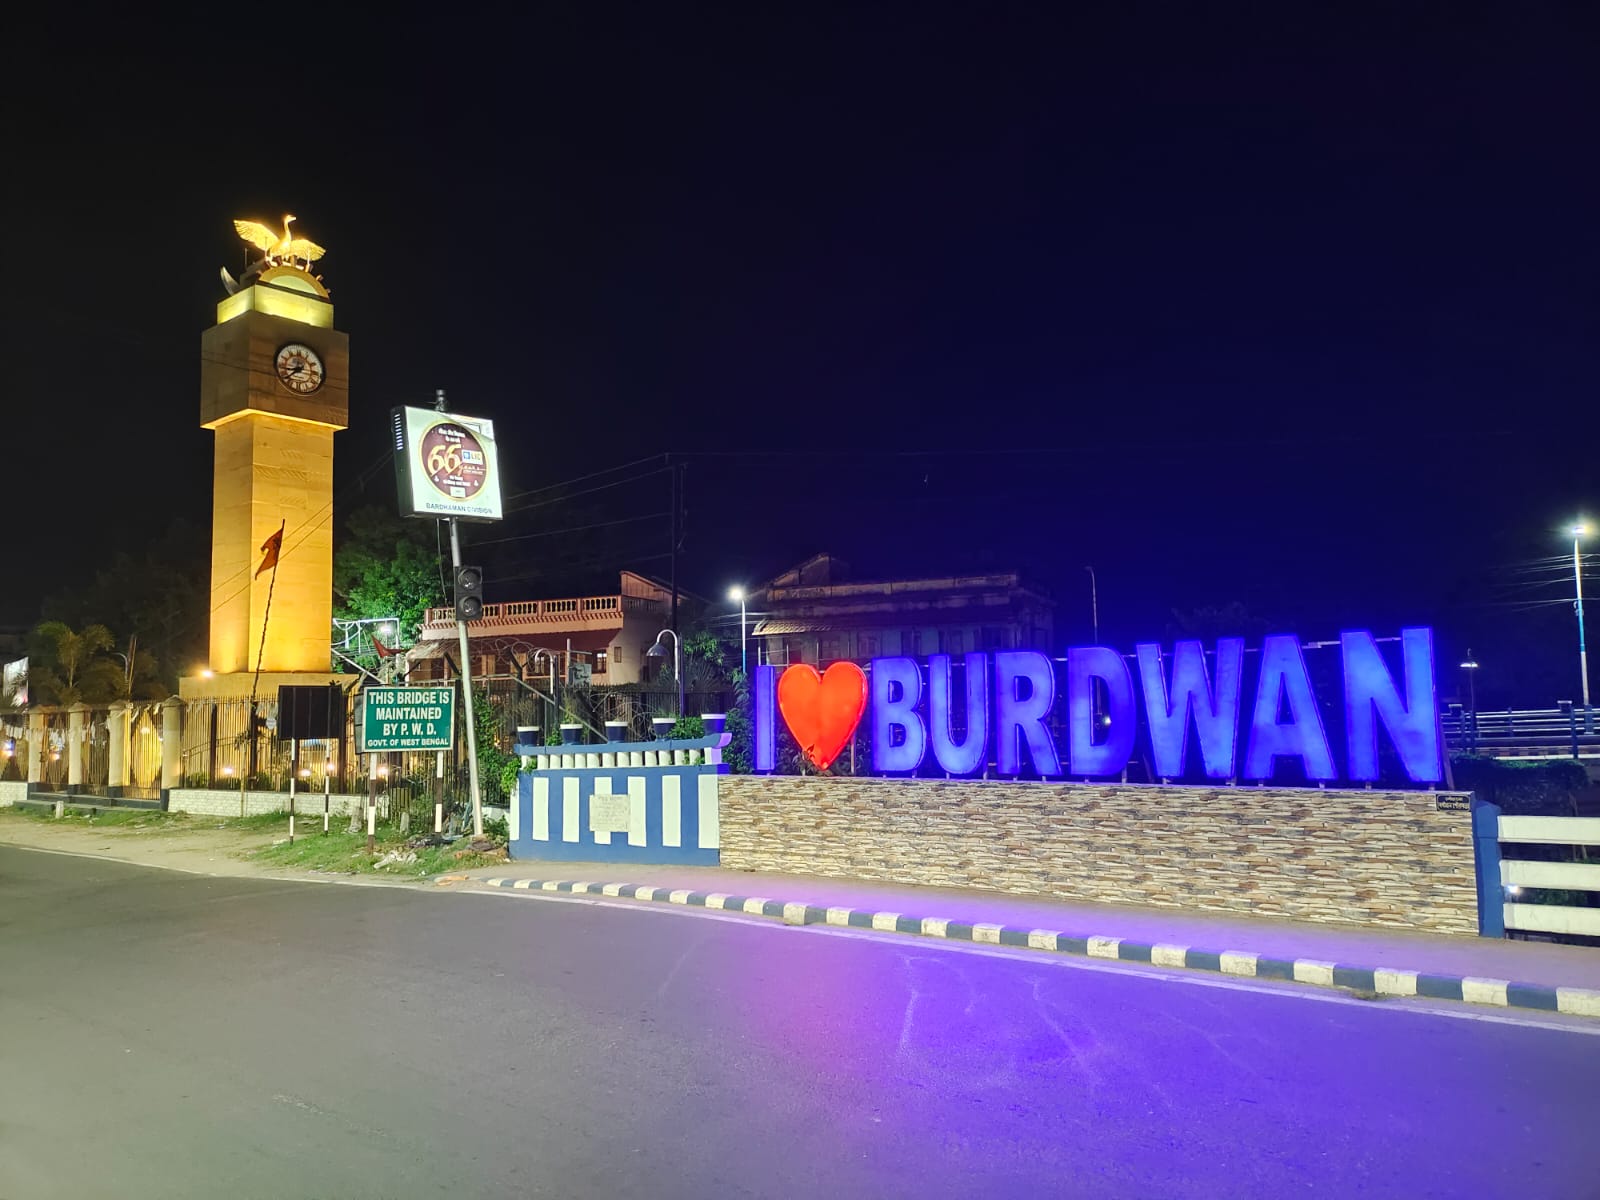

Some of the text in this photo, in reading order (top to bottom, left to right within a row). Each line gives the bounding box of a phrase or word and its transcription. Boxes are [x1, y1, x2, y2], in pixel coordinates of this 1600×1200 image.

[427, 444, 462, 477] 66
[426, 502, 466, 512] BARDHAMAN
[369, 691, 450, 704] THIS BRIDGE IS
[755, 627, 1443, 784] I BURDWAN
[376, 707, 442, 720] MAINTAINED
[383, 723, 398, 736] BY
[367, 739, 388, 747] GOVT.
[401, 738, 419, 746] WEST
[421, 738, 449, 746] BENGAL
